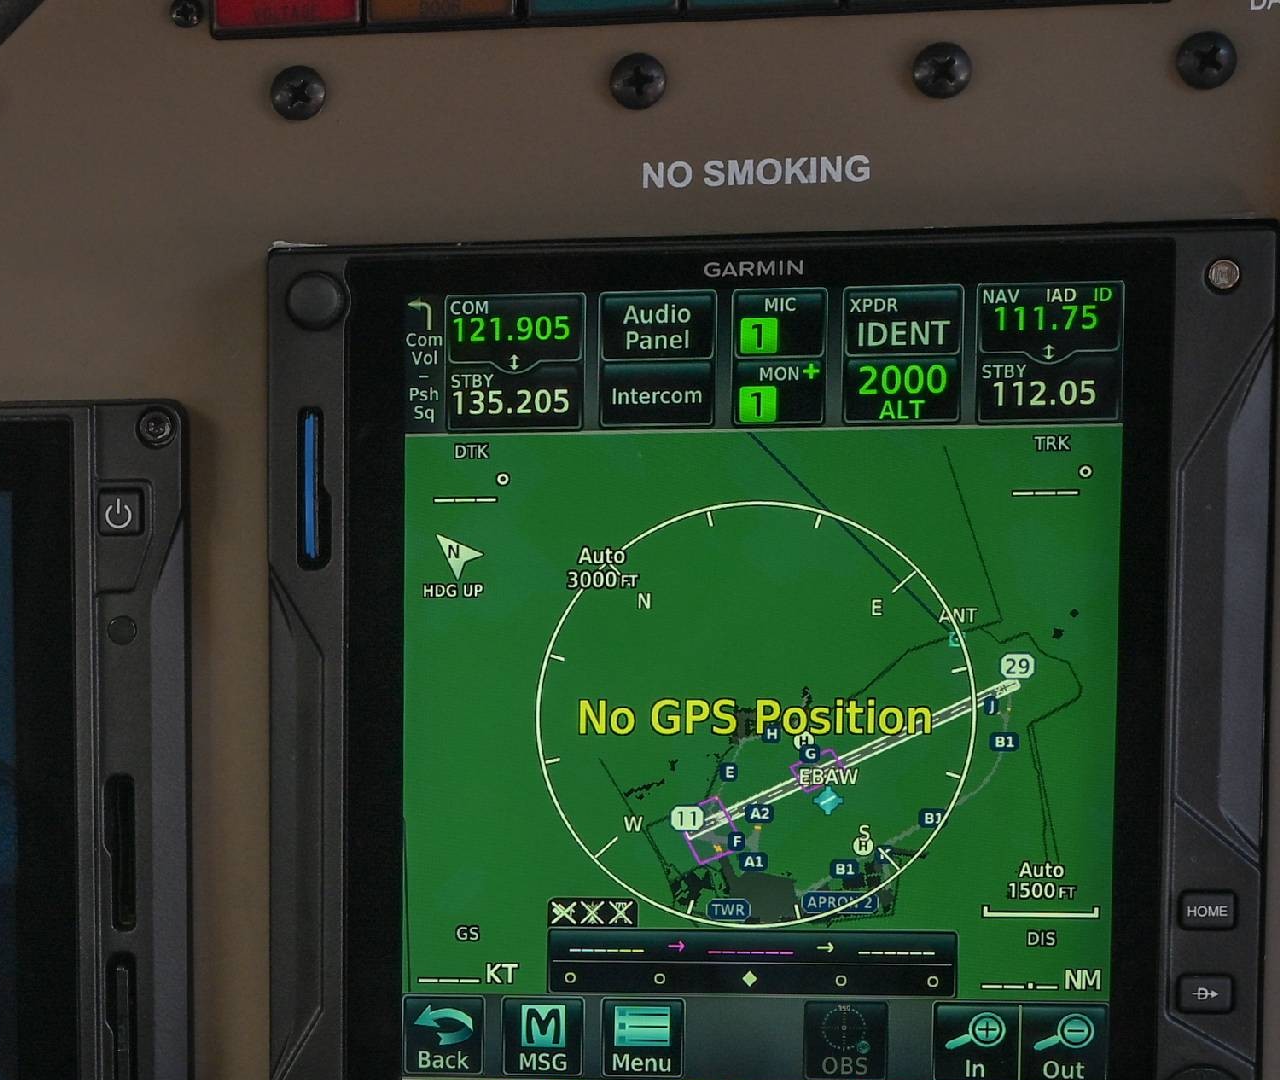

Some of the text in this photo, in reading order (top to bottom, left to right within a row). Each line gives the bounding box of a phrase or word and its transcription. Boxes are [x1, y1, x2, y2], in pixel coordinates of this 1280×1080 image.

[643, 154, 870, 189] NO SMOKING
[703, 259, 804, 279] GARMIN
[764, 297, 797, 313] MIC
[850, 297, 898, 313] XPDR
[982, 287, 1112, 305] NAV IAD ID
[450, 301, 489, 315] COM
[623, 304, 691, 325] Audio
[995, 305, 1099, 332] 111.75
[452, 316, 570, 342] 121.905
[857, 320, 951, 348] IDENT
[626, 330, 690, 350] Panel
[759, 366, 800, 382] MON
[858, 364, 947, 396] 2000
[982, 364, 1026, 380] STBY
[451, 374, 493, 389] STBY
[452, 389, 570, 415] 135.205
[612, 387, 703, 405] Intercom
[994, 380, 1096, 407] 112.05
[878, 400, 926, 420] ALT
[454, 445, 489, 459] DTK
[1034, 436, 1071, 451] TRK
[578, 547, 626, 564] Auto
[567, 572, 639, 588] 3000 FT
[423, 584, 484, 598] HDG UP
[1005, 659, 1030, 674] 29
[578, 697, 933, 736] No GPS Position
[799, 768, 858, 787] EBAW
[1186, 905, 1228, 918] HOME
[1026, 931, 1057, 947] DIS
[485, 963, 519, 984] KT
[418, 1051, 470, 1069] Back
[519, 1054, 567, 1071] MSG
[612, 1055, 672, 1072] Menu
[965, 1059, 985, 1078] In
[1042, 1060, 1085, 1080] Out
